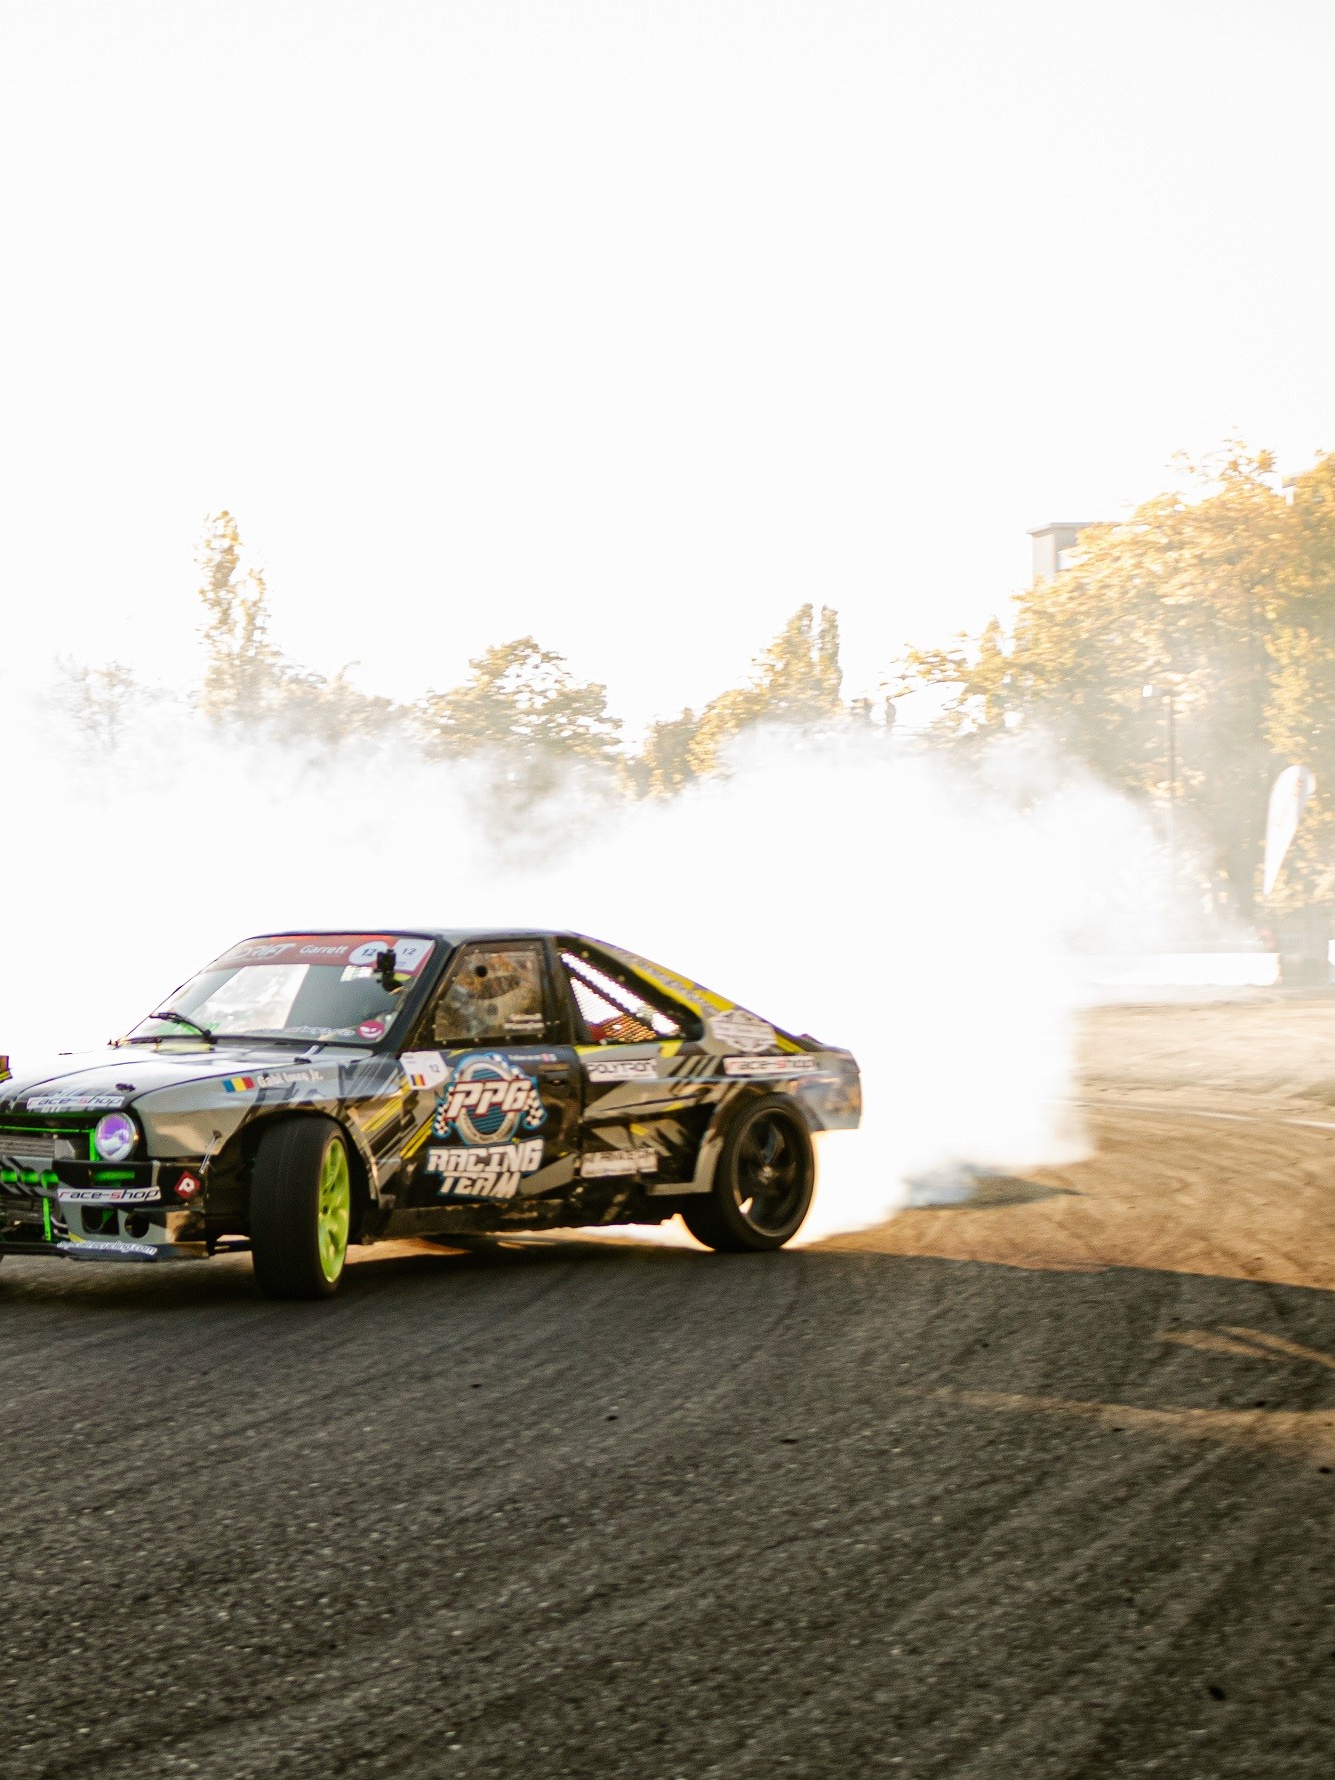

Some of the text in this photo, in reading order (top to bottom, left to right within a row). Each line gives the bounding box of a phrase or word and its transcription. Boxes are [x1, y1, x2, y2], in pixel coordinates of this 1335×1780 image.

[299, 945, 349, 955] Garrett
[446, 1080, 532, 1118] PPG
[427, 1138, 544, 1172] RACING
[58, 1188, 159, 1201] race-shop
[440, 1171, 521, 1199] TEAM
